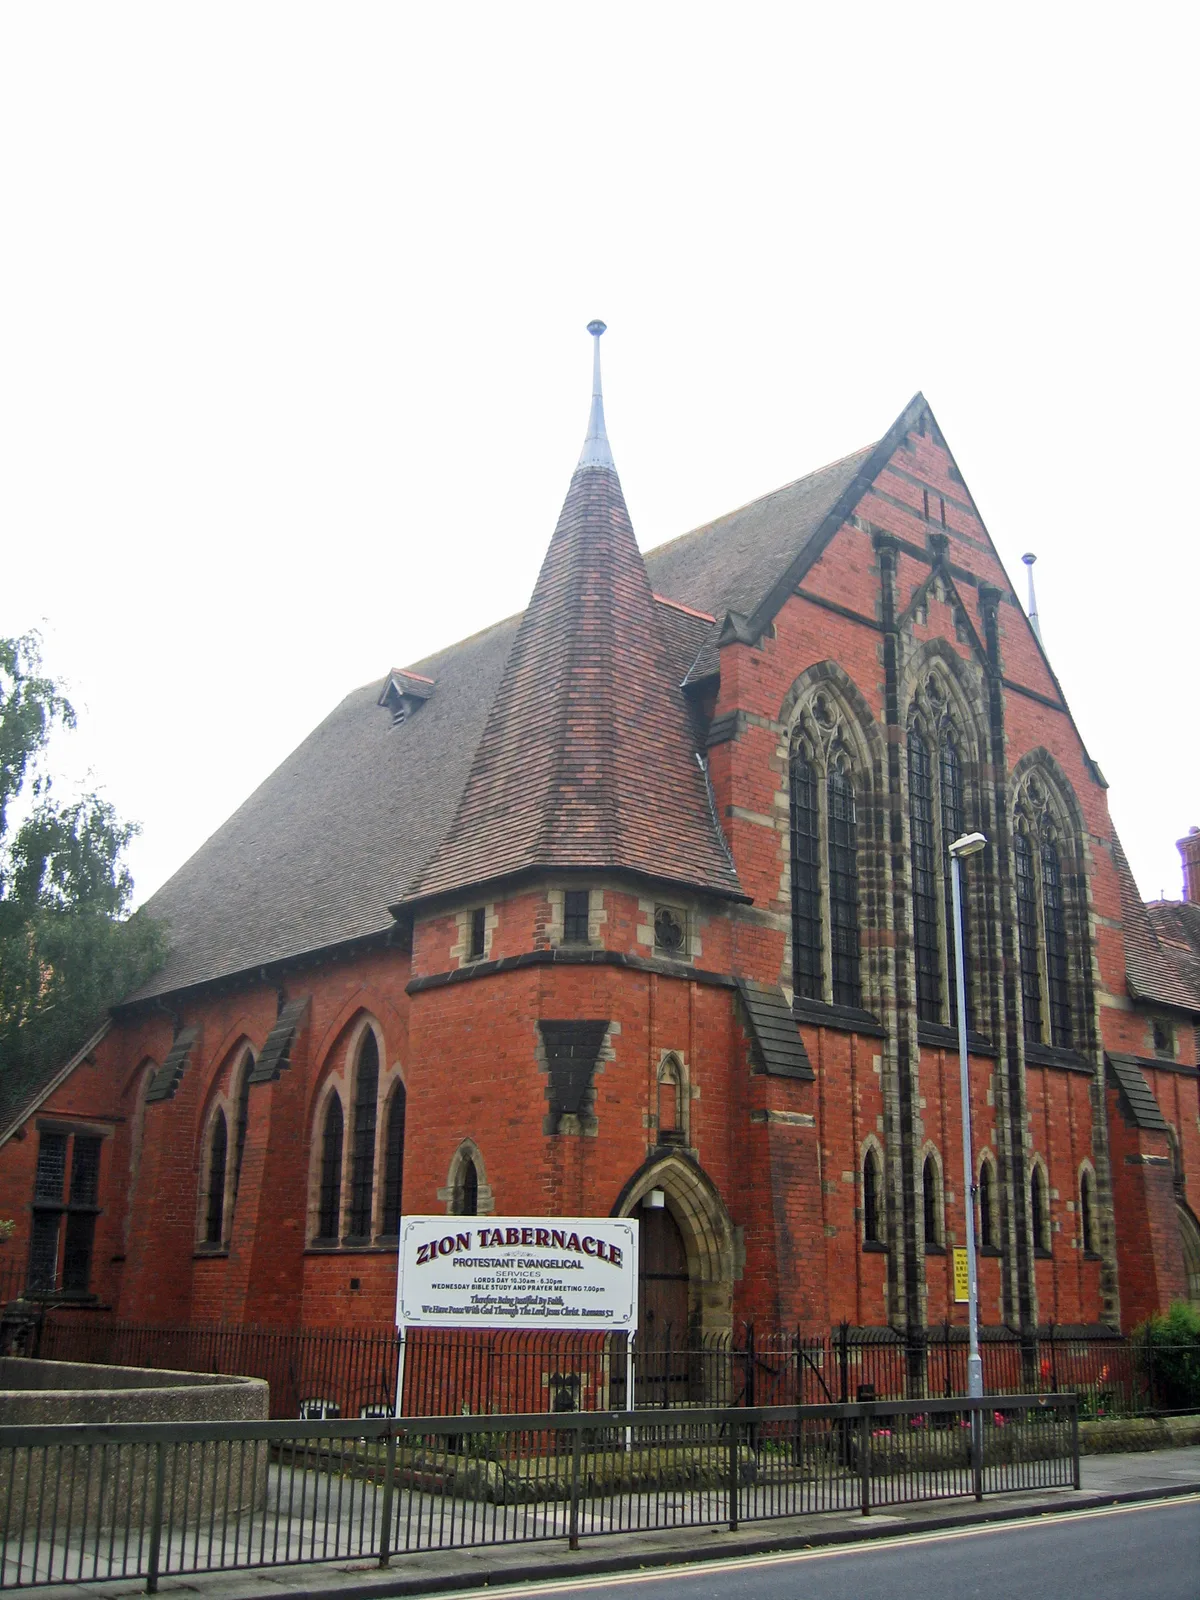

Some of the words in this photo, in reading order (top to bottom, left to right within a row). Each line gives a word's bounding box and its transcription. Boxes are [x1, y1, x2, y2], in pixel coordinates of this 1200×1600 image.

[416, 1231, 472, 1266] ZION
[477, 1227, 623, 1269] TABERNACLE
[453, 1258, 514, 1268] PROTESTANT
[517, 1259, 584, 1270] EVANGELICAL
